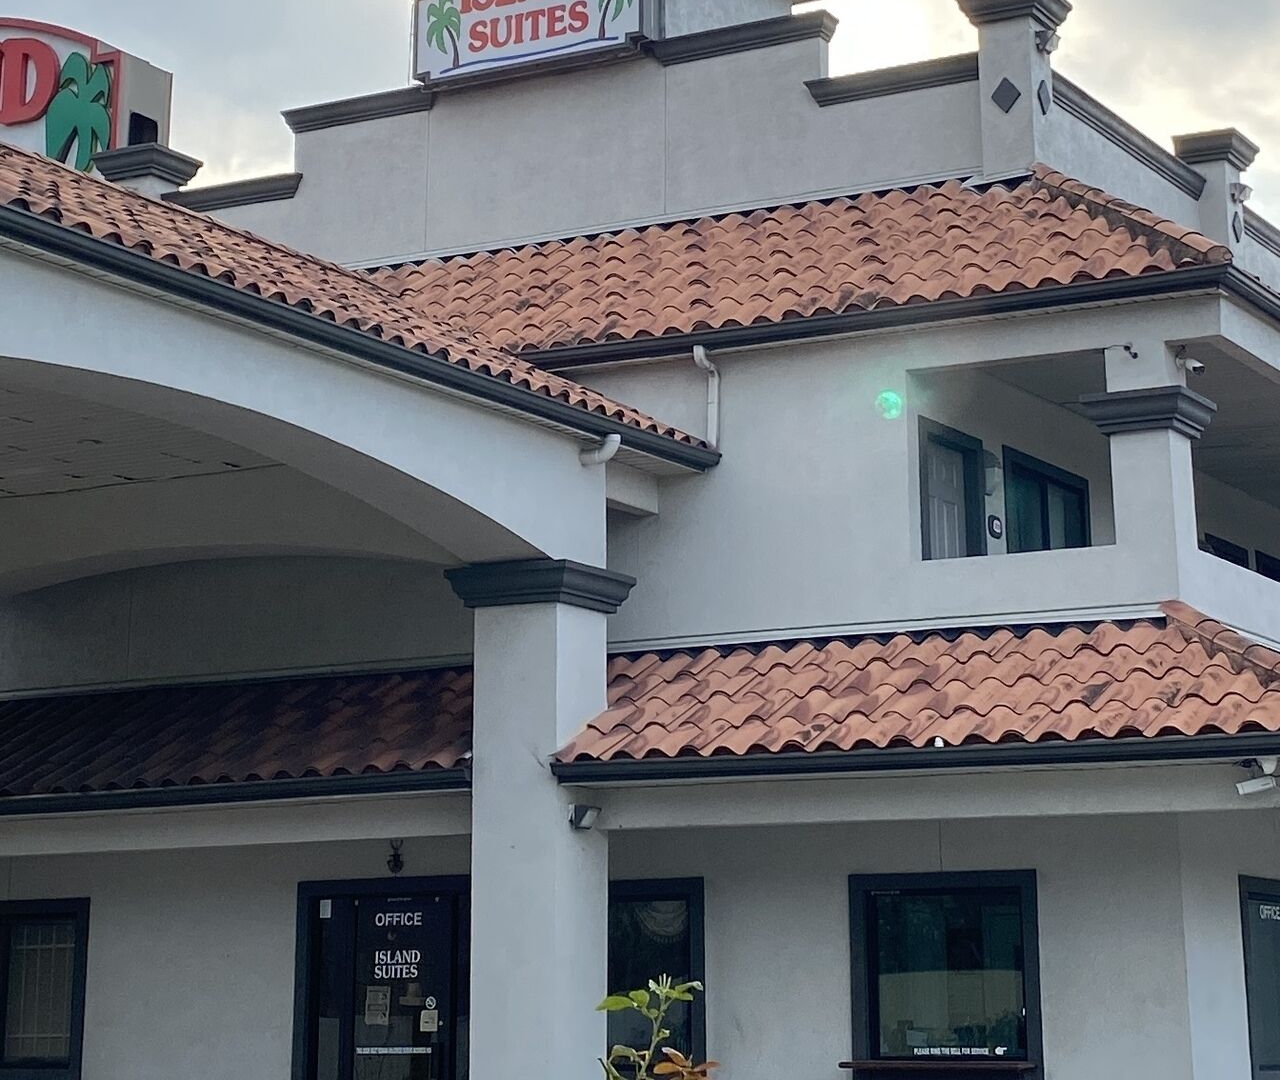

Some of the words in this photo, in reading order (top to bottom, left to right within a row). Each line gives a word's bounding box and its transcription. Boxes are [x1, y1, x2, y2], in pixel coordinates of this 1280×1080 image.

[467, 0, 589, 53] SUITES
[375, 911, 423, 927] OFFICE
[1259, 904, 1280, 920] OFFICE
[374, 949, 421, 965] ISLAND
[374, 964, 419, 979] SUITES
